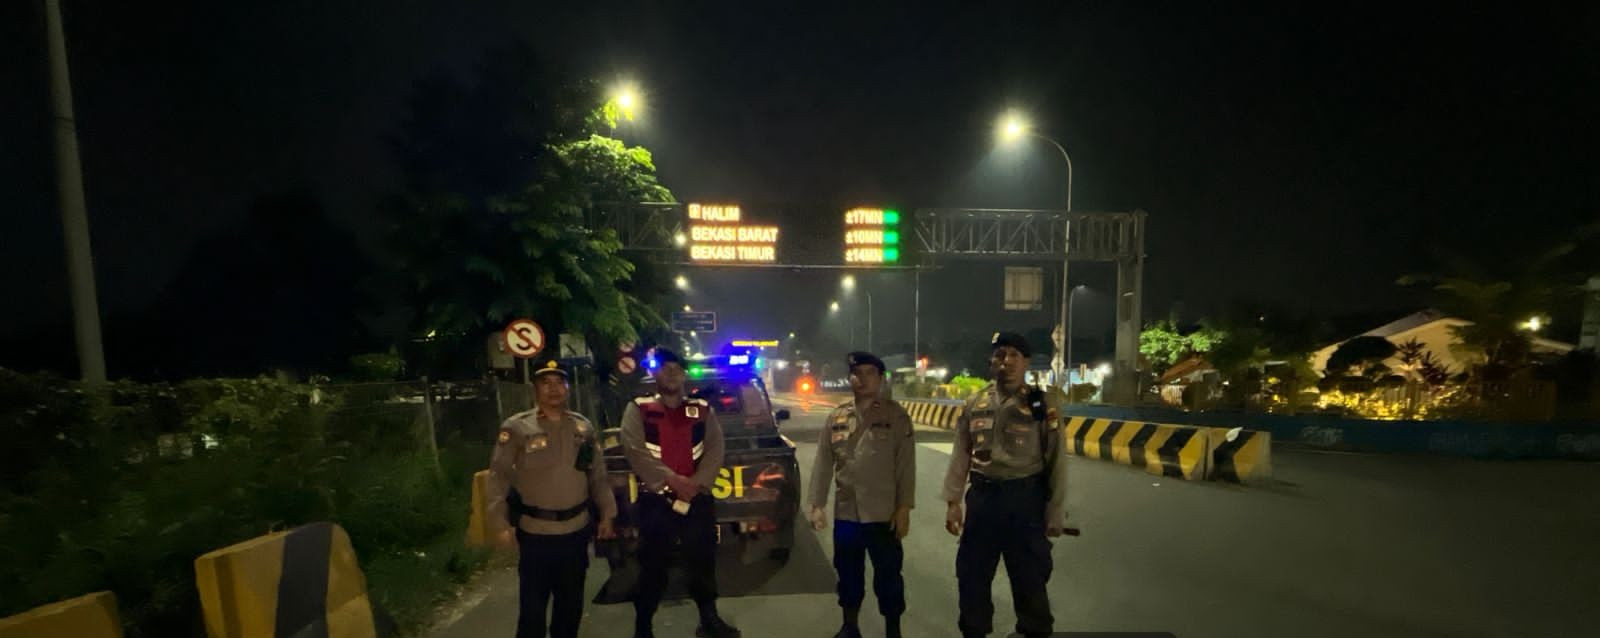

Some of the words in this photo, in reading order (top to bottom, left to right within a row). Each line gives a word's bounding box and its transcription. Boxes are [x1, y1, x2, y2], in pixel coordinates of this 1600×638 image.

[702, 205, 740, 221] HALIM
[691, 226, 736, 241] BEKASI
[738, 227, 778, 242] BARAT
[690, 245, 736, 260] BEKASI
[737, 246, 775, 261] TIMUR
